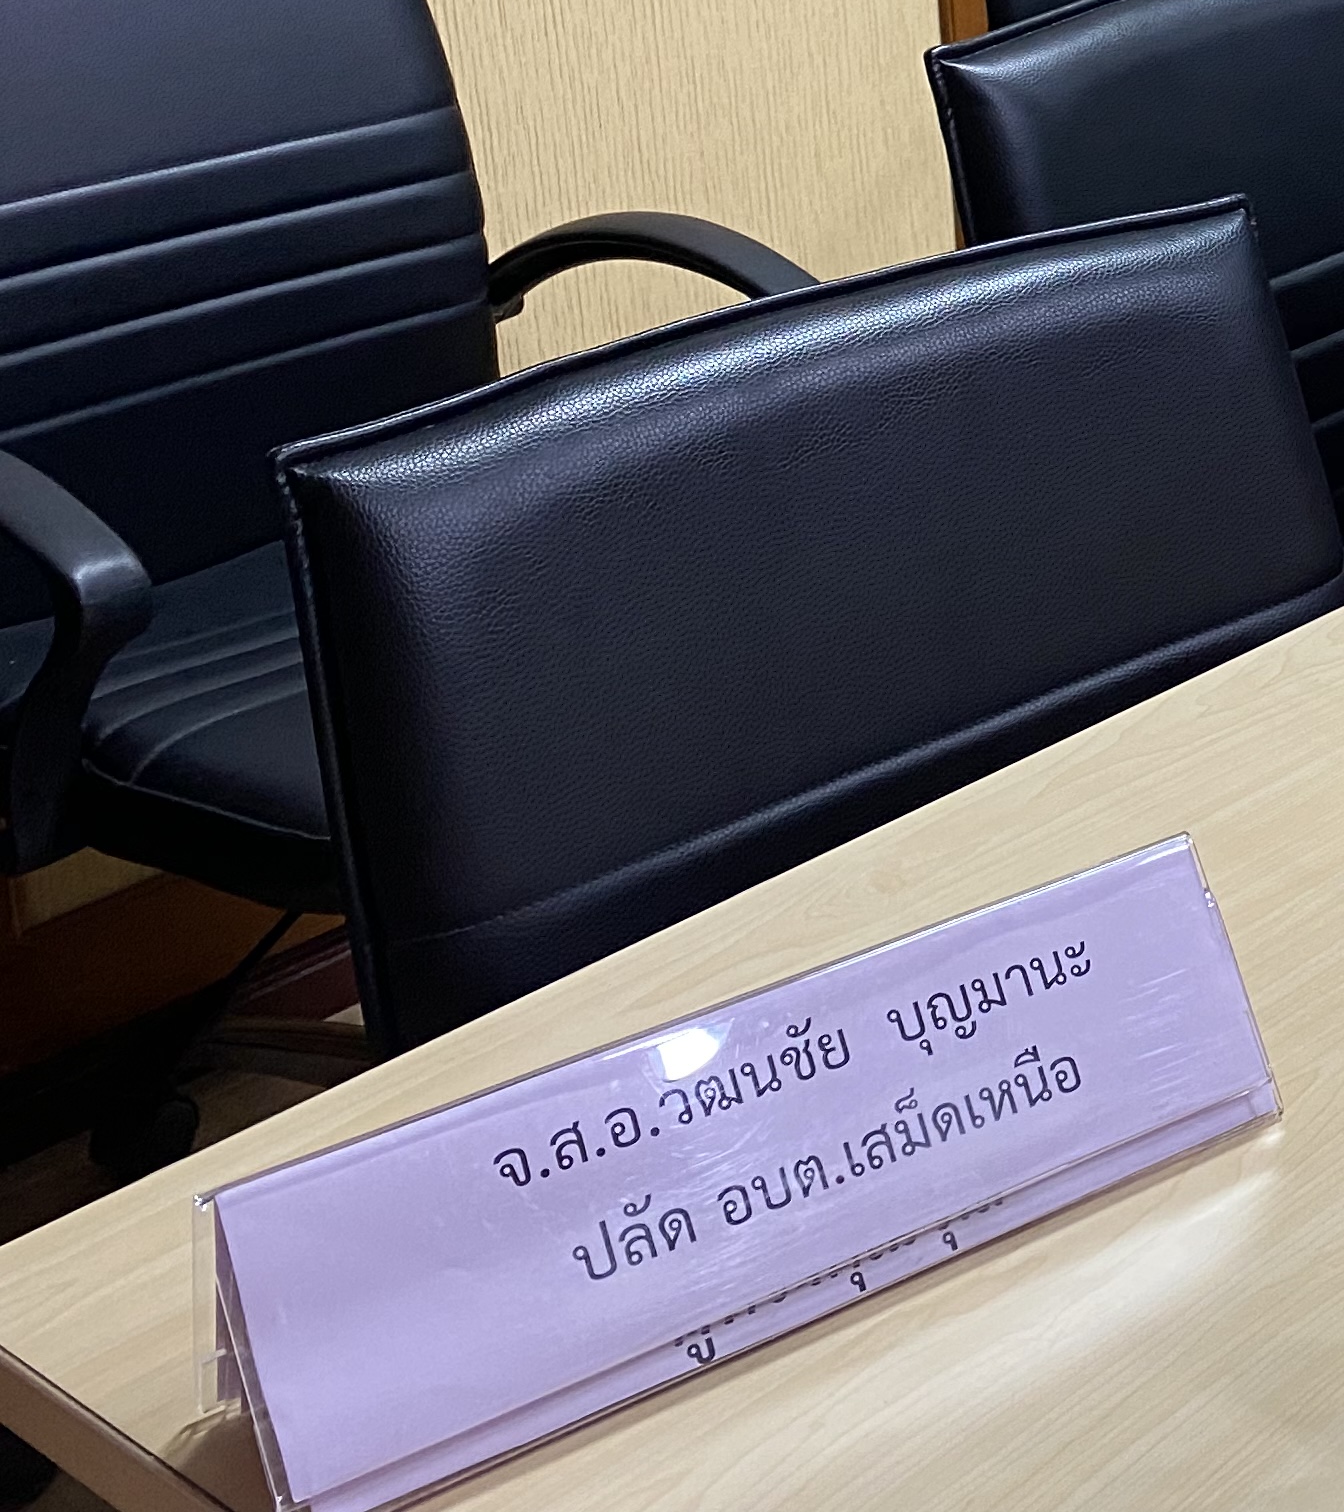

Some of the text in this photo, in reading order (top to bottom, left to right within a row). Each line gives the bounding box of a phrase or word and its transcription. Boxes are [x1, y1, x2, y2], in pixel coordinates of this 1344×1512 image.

[493, 939, 1093, 1187] จ.ส.อ.วฒนชัย บุญมานะ
[572, 1044, 1082, 1281] ปลัด อบต.เสม็ดเหนือ
